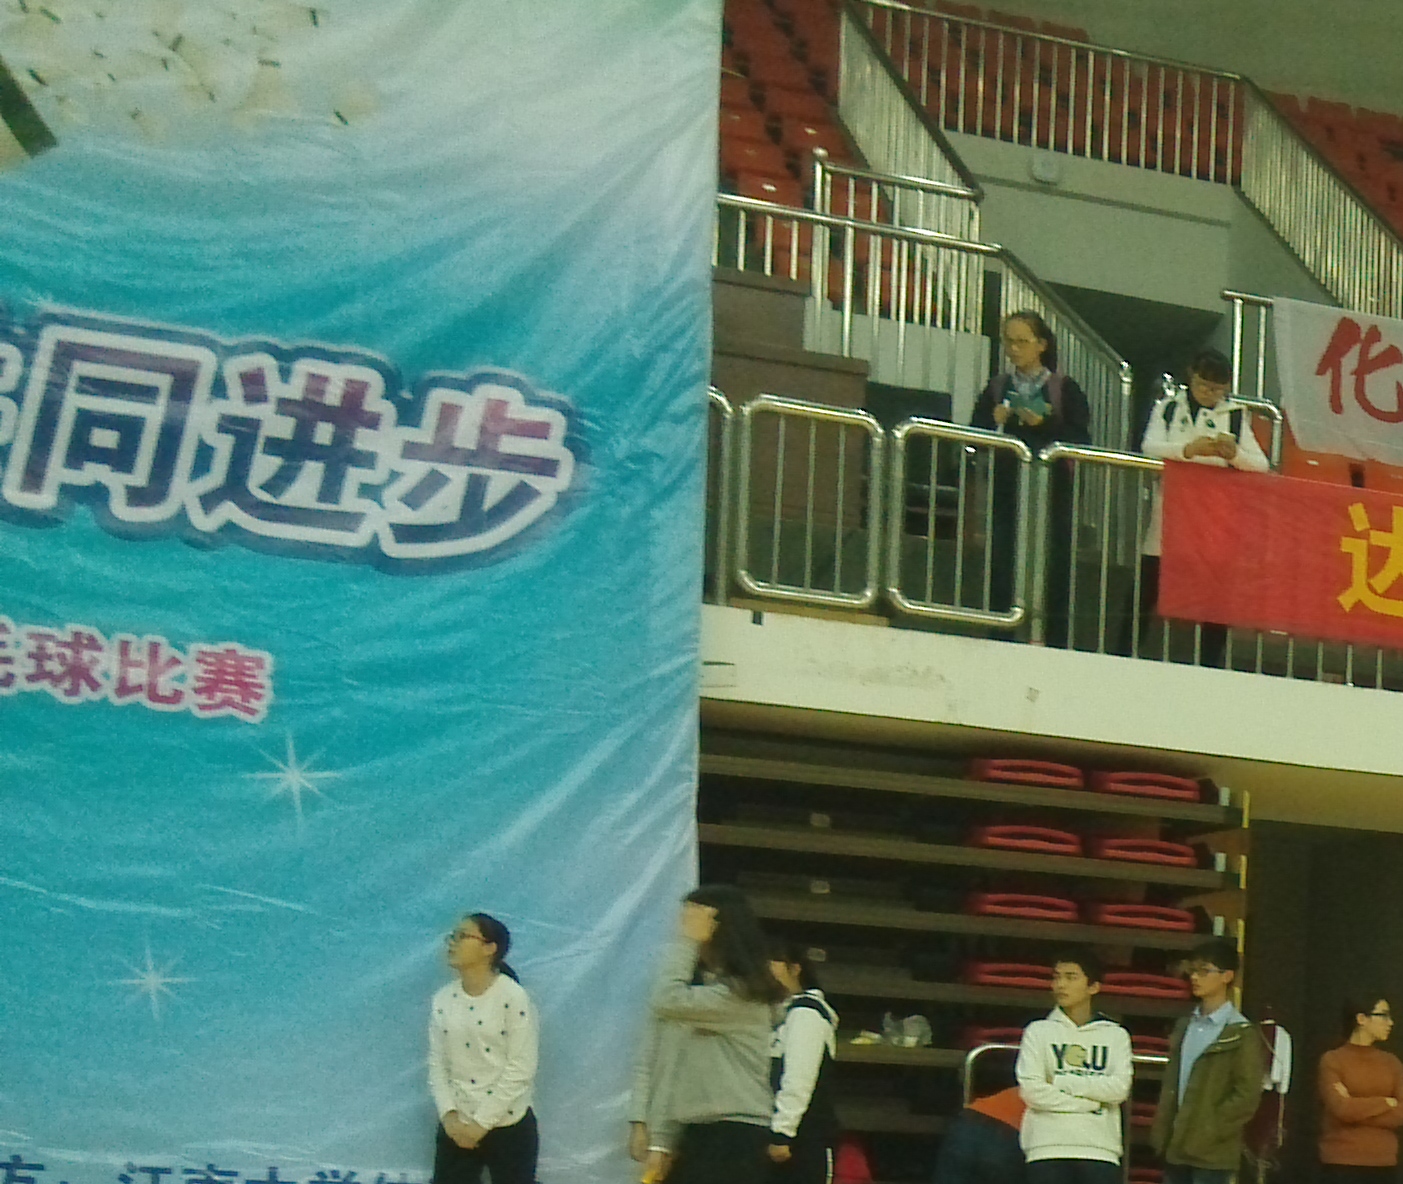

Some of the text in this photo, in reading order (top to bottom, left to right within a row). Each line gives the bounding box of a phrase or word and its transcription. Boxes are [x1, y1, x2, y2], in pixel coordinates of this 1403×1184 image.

[0, 325, 577, 561] 同进步
[0, 612, 272, 722] 球比赛
